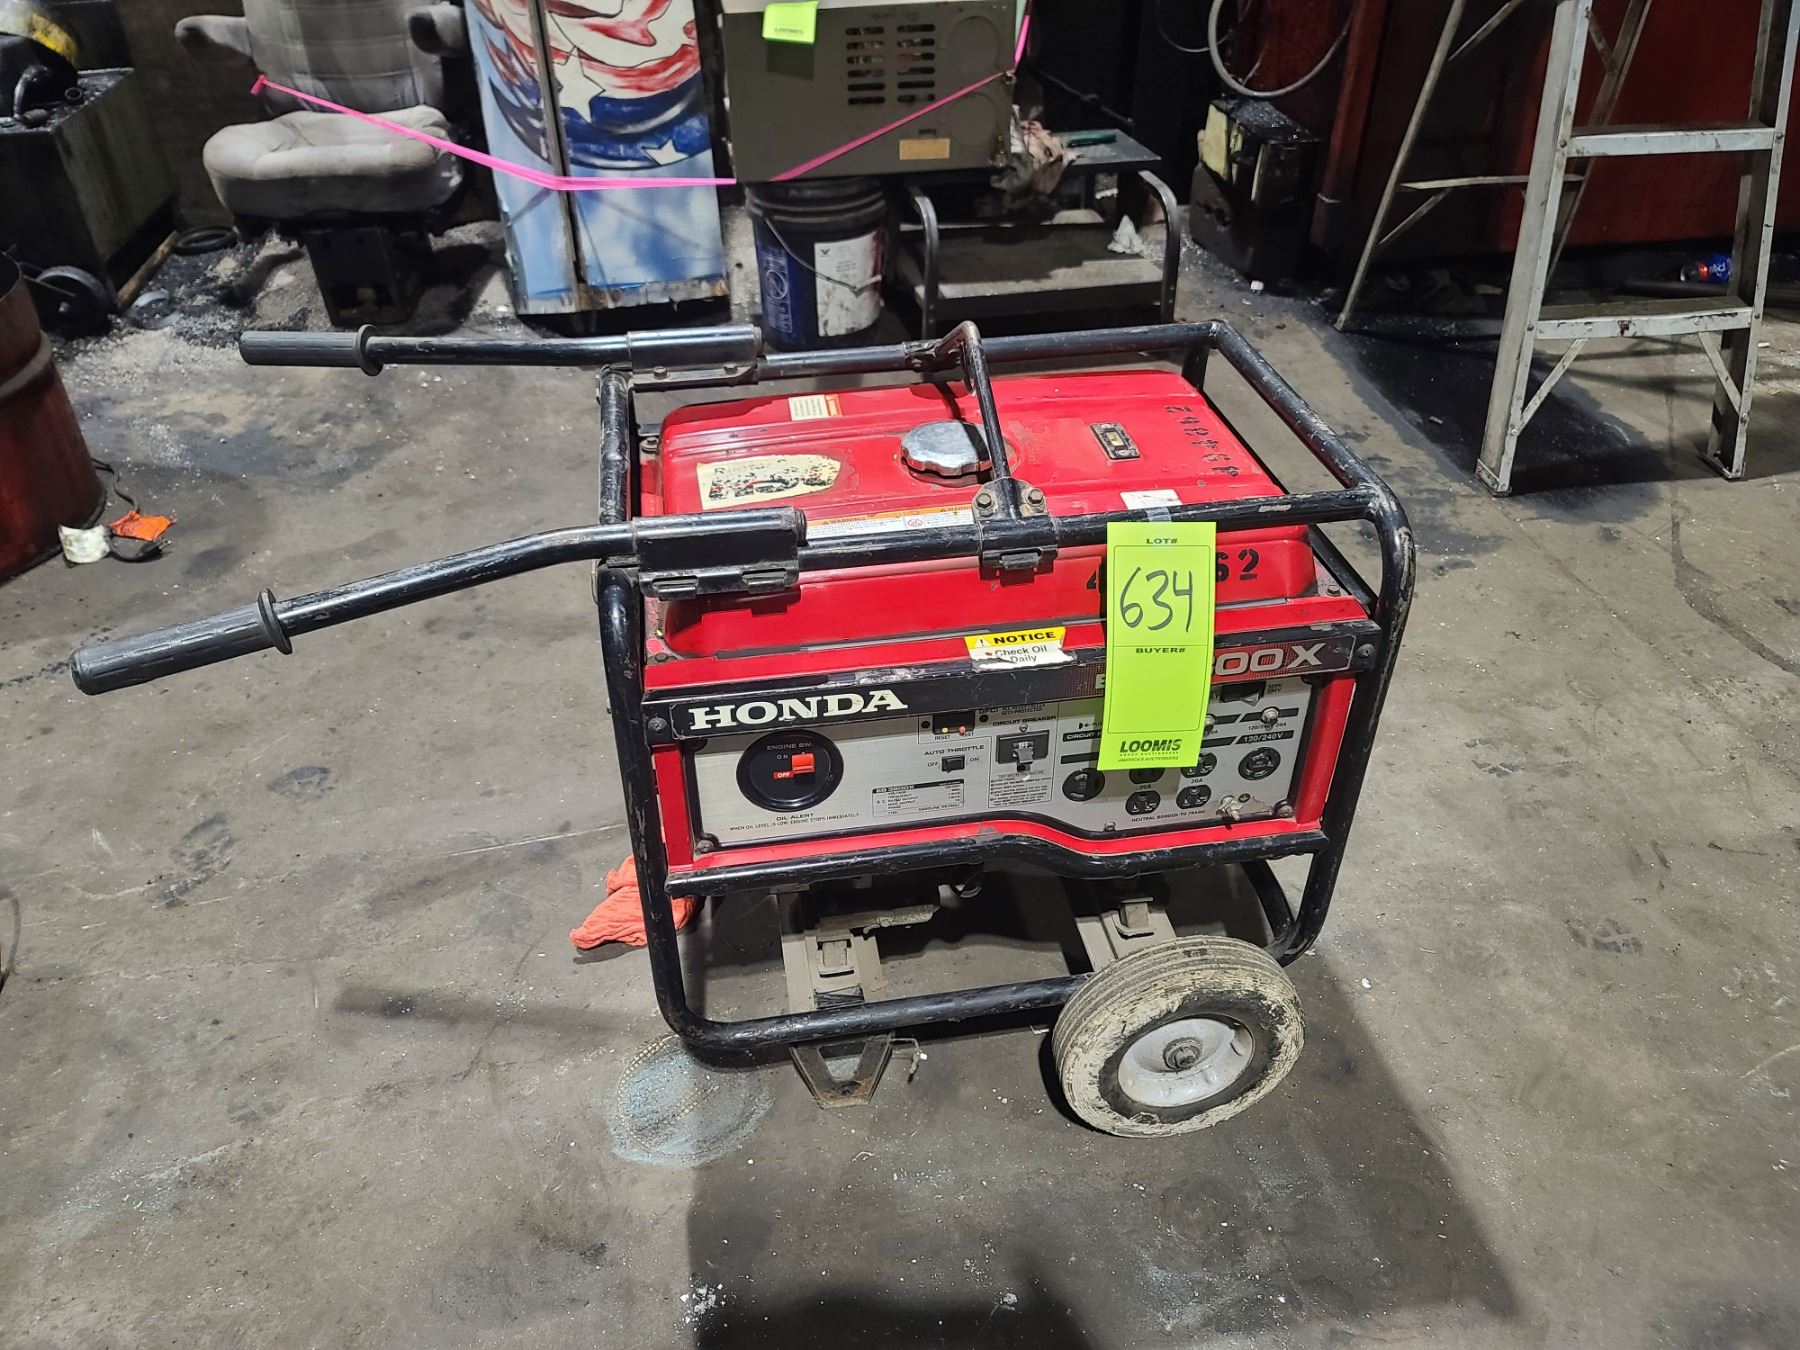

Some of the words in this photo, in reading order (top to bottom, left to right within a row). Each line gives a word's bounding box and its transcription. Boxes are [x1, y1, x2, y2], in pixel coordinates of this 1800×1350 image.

[1120, 566, 1194, 633] 634
[993, 631, 1056, 644] NOTICE
[995, 648, 1029, 657] Check
[1032, 644, 1048, 653] Oil
[1010, 655, 1037, 664] Daily
[688, 689, 908, 730] HONDA
[1243, 732, 1283, 743] 120/240V
[924, 748, 945, 756] AUTO
[947, 745, 985, 753] THROTTLE
[1119, 739, 1182, 752] LOOMIS
[1131, 814, 1155, 822] NEUTRAL
